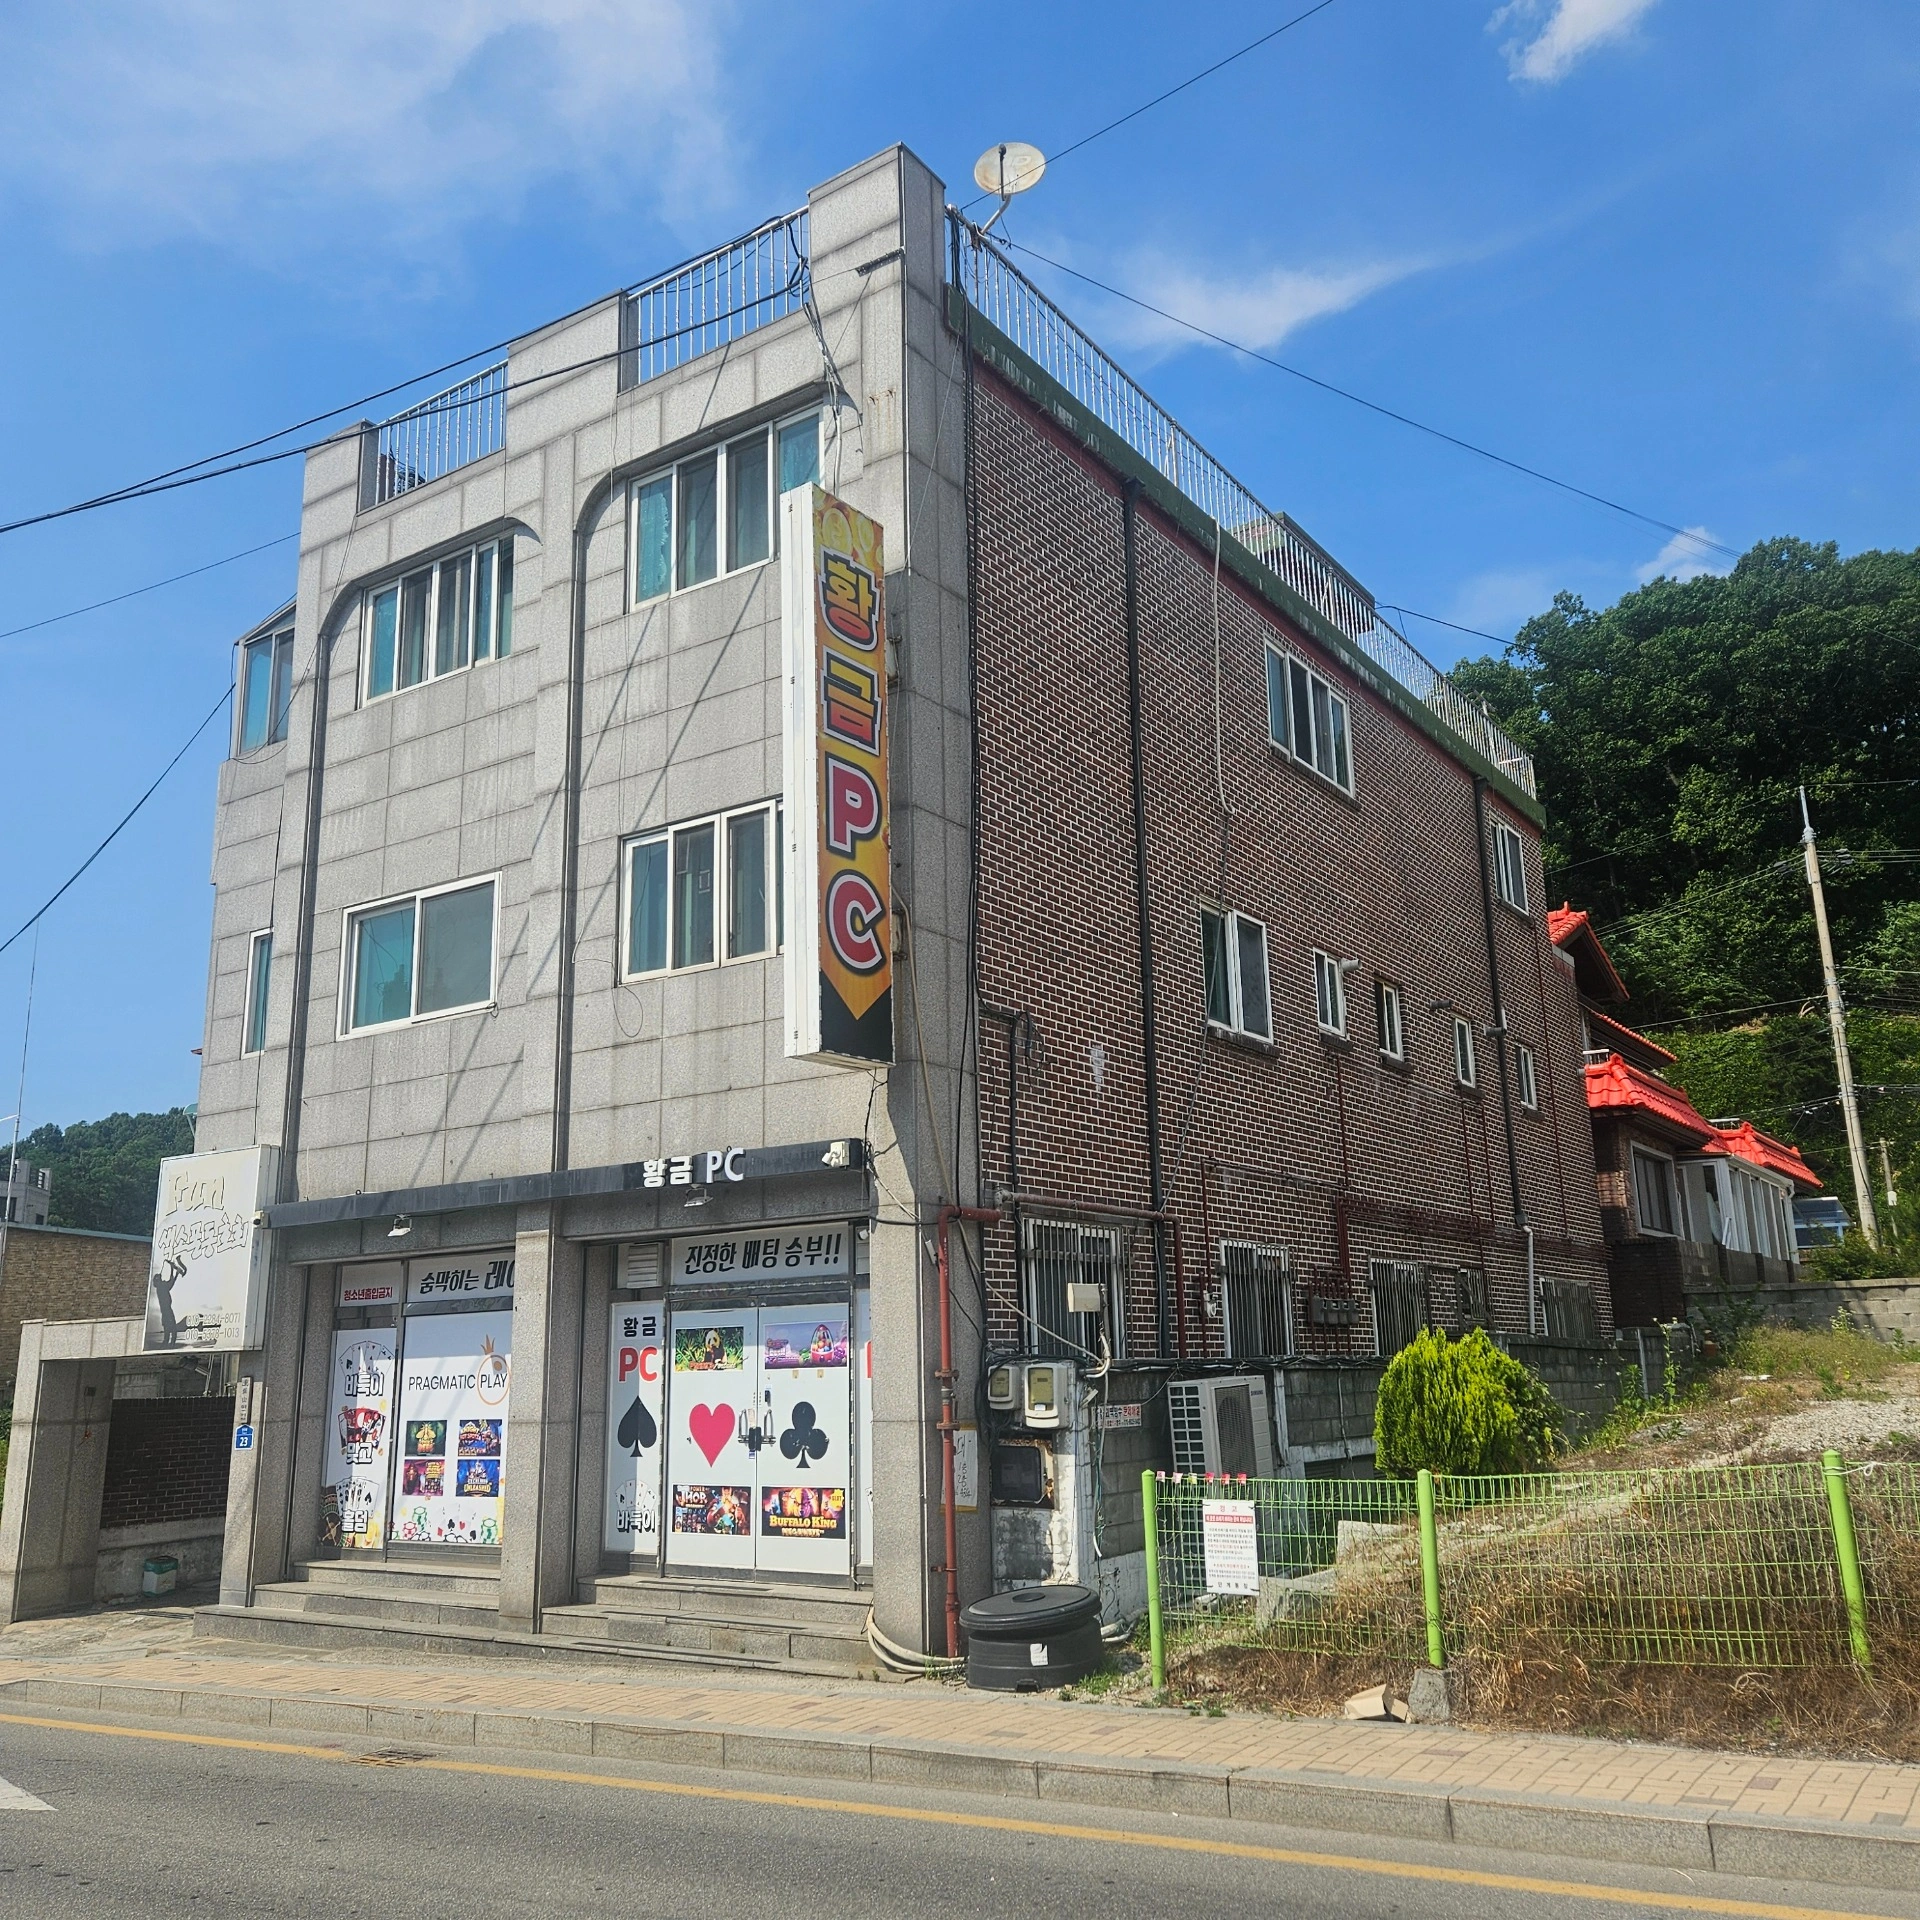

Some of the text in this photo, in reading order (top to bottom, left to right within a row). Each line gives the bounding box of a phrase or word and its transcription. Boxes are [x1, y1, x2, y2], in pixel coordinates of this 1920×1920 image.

[642, 1147, 746, 1188] 황금 PC
[165, 1171, 225, 1217] Fun
[685, 1233, 842, 1275] 진정한 배팅 승부!!
[419, 1260, 515, 1295] 숨막히는 레
[344, 1286, 393, 1301] 청소년출입금지
[185, 1328, 240, 1341] 010-5378-1013
[623, 1316, 657, 1338] 황금
[618, 1345, 659, 1383] PC
[345, 1373, 385, 1397] 바둑이
[408, 1373, 508, 1391] PRAGMATIC PLAY
[239, 1436, 249, 1447] 23
[346, 1441, 373, 1465] 맞고
[341, 1509, 368, 1534] 홀덤
[616, 1510, 656, 1533] 바둑이
